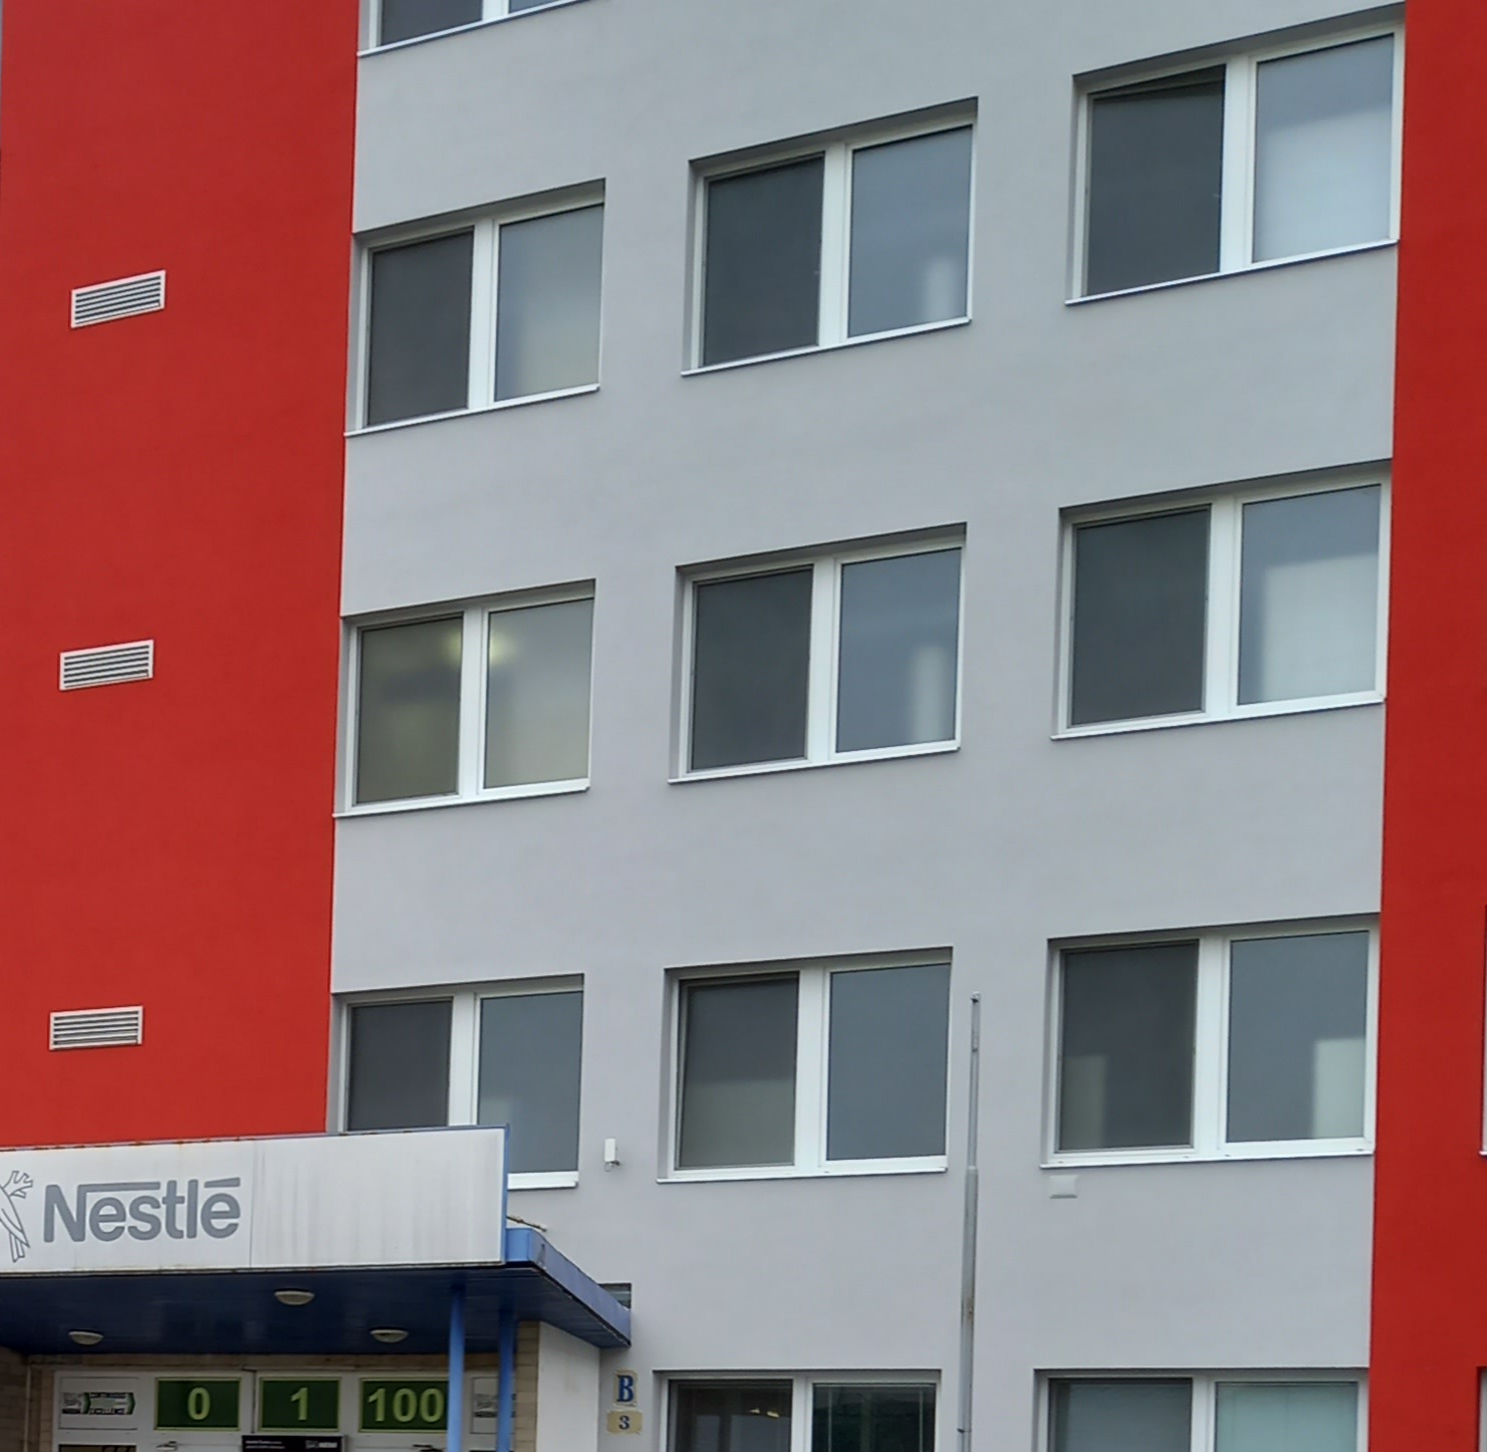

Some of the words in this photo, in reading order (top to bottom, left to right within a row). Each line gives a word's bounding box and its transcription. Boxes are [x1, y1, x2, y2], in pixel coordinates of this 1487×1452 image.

[43, 1177, 241, 1243] Nestlé
[187, 1387, 211, 1420] 0
[290, 1387, 309, 1421] 1
[616, 1374, 635, 1402] B
[368, 1388, 445, 1422] 100
[618, 1415, 631, 1430] 3
